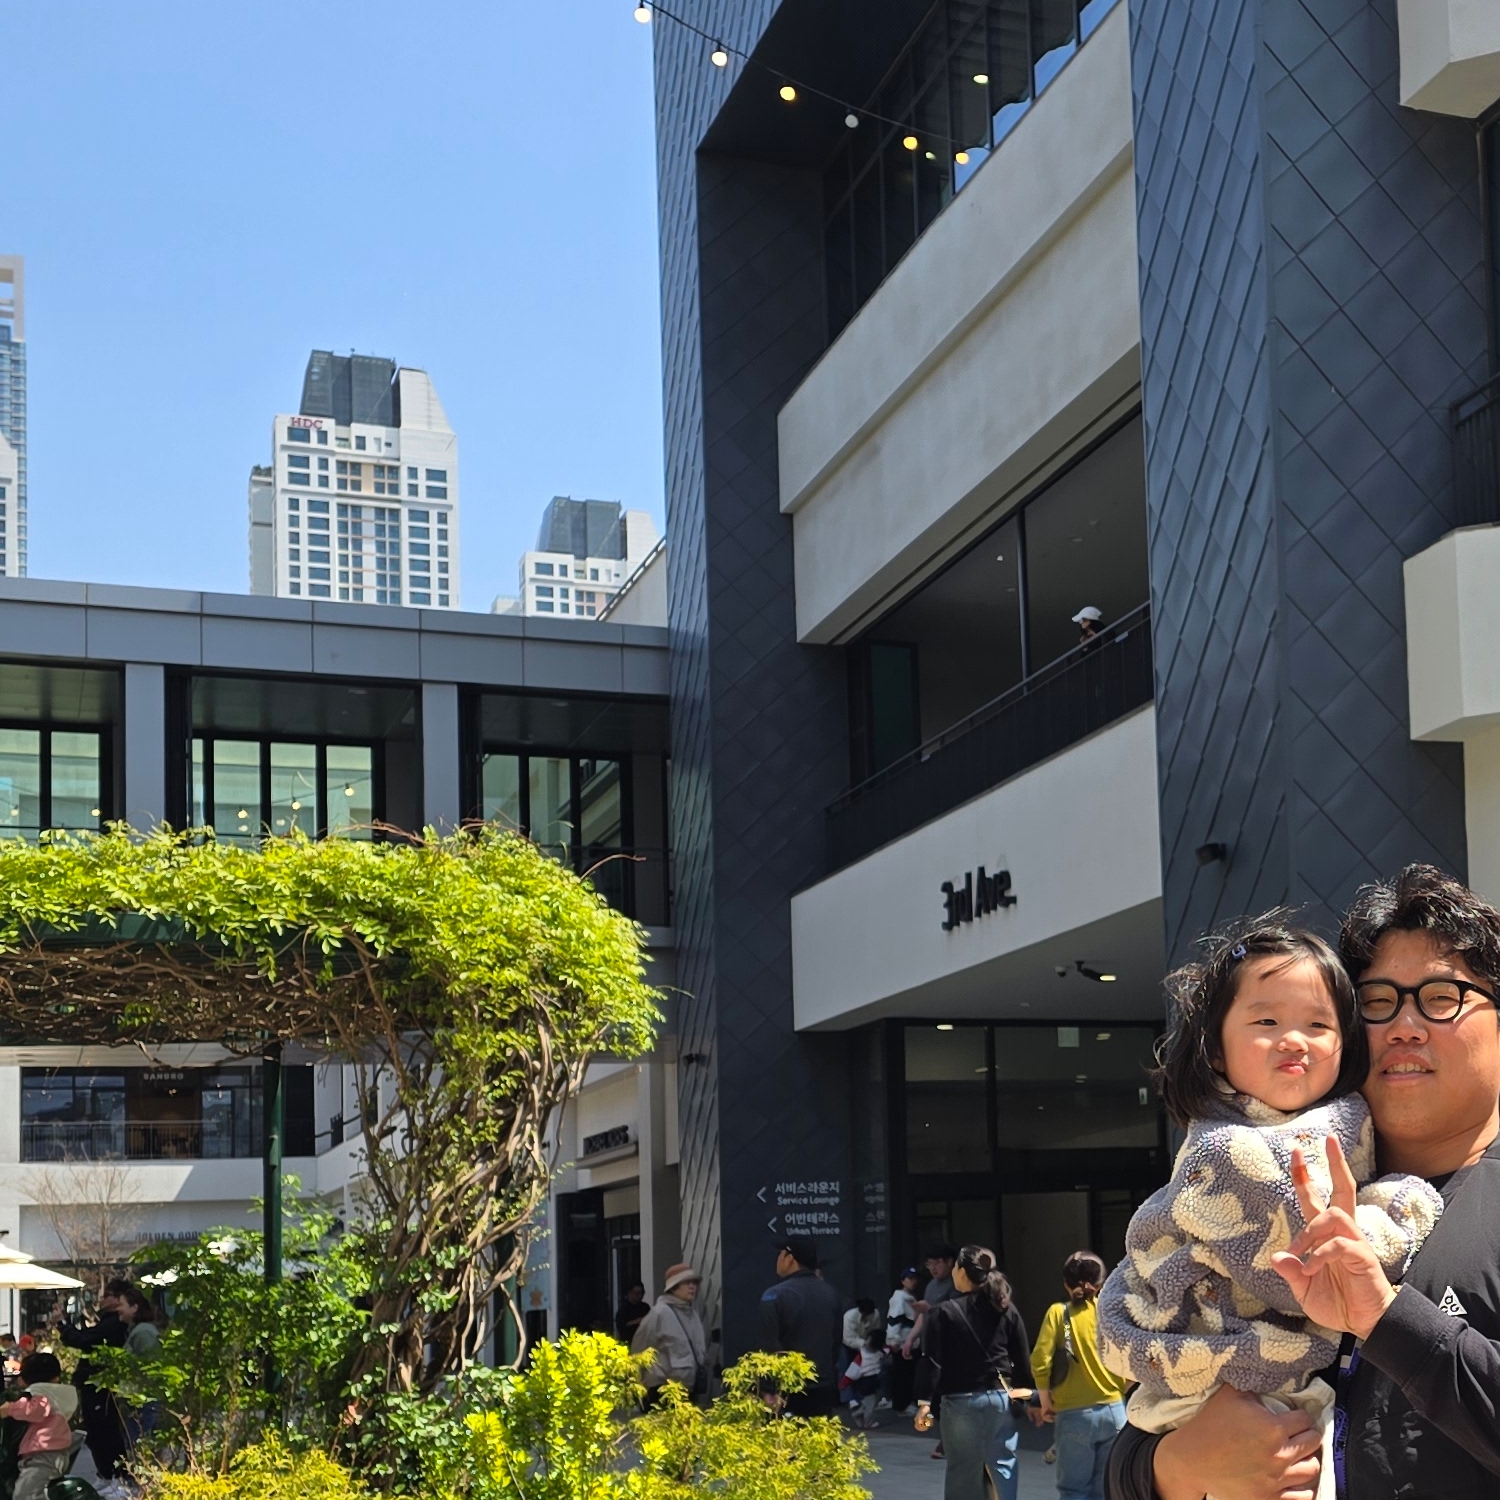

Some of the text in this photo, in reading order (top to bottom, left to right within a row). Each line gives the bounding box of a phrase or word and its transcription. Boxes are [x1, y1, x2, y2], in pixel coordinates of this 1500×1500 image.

[291, 417, 324, 430] HDC
[940, 865, 1018, 932] 3rd Ave.
[774, 1181, 840, 1195] 서비스라운지
[777, 1195, 840, 1206] Service Lounge
[784, 1211, 840, 1225] 어반테라스
